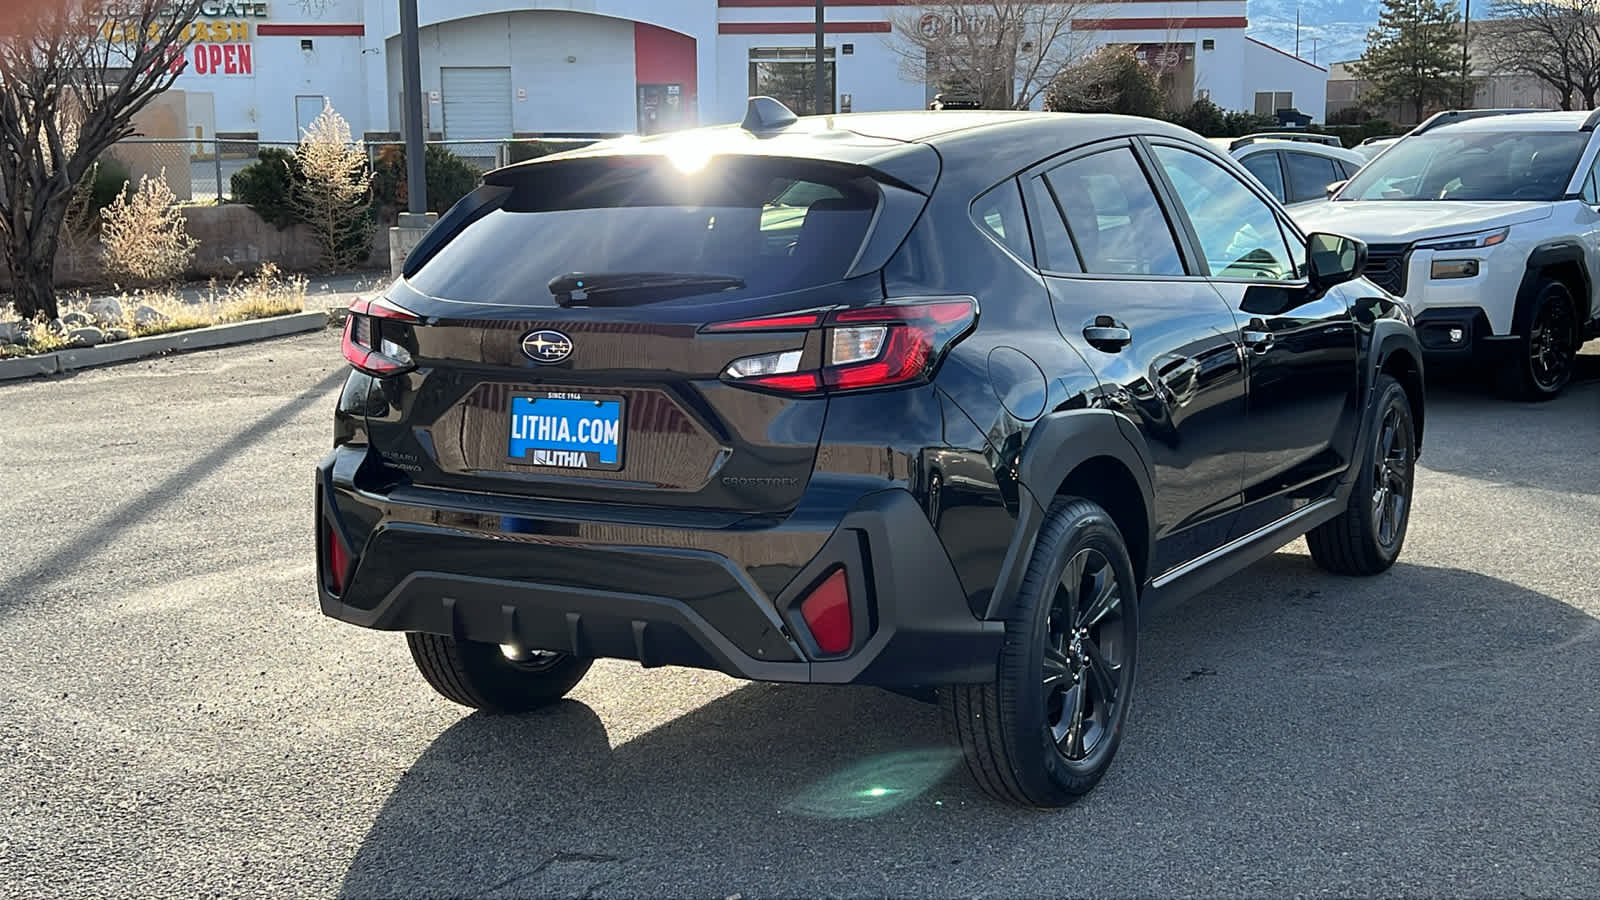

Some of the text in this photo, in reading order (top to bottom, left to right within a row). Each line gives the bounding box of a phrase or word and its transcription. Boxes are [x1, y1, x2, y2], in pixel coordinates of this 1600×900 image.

[199, 0, 268, 18] GATE
[194, 44, 252, 75] OPEN
[511, 414, 619, 446] LITHIA.COM
[546, 451, 588, 468] LITHIA
[722, 476, 800, 488] CROSSTREK
